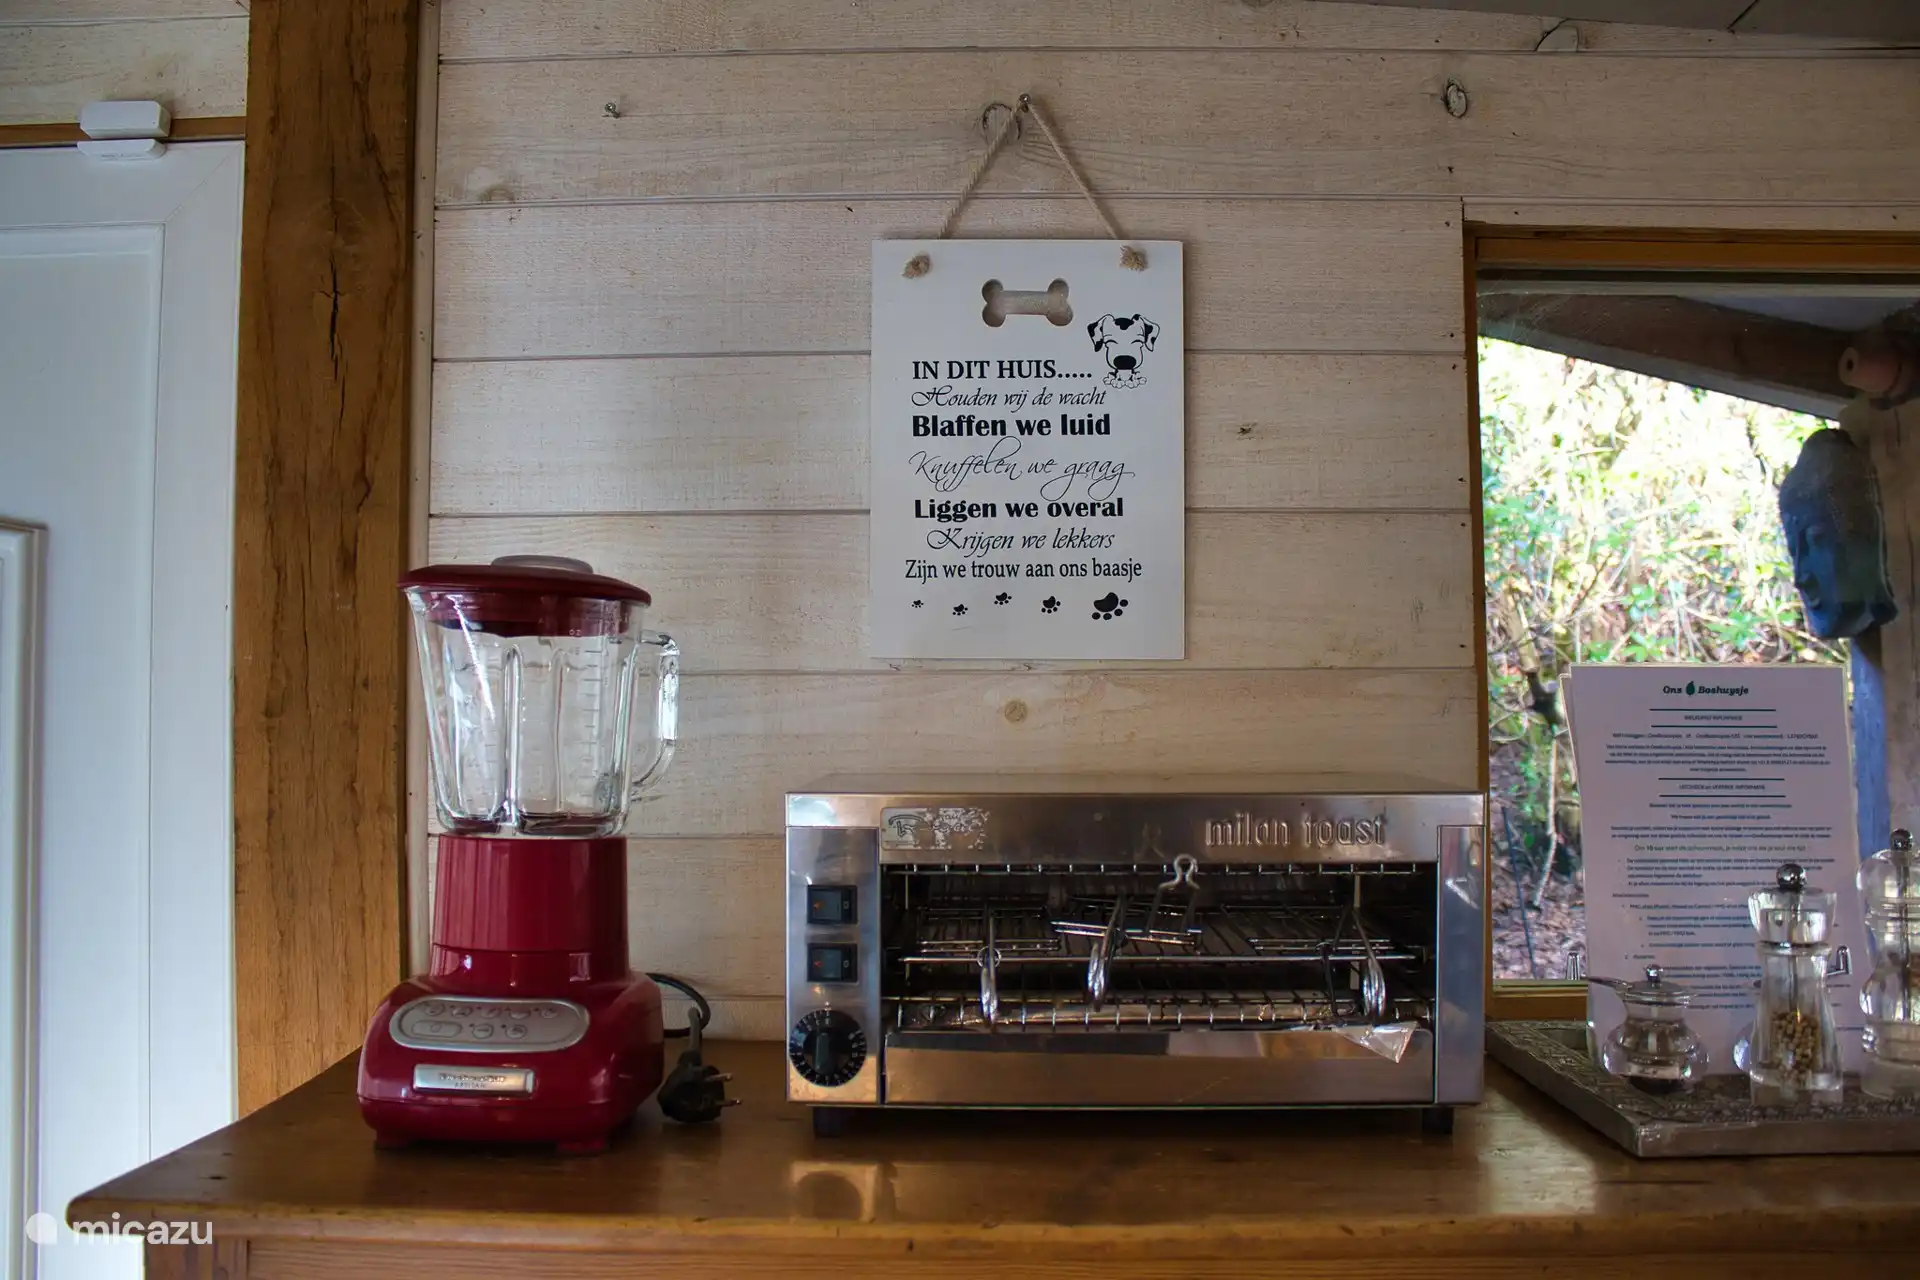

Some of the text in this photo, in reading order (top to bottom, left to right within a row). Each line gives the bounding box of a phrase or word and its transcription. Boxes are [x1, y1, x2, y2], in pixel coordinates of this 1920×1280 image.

[912, 361, 939, 379] IN
[946, 360, 990, 379] DIT
[911, 385, 1107, 413] Houden wij de wacht
[911, 413, 1111, 437] Blaffen we luid
[908, 435, 1136, 502] Knuffelen we graag
[914, 497, 1124, 523] Liggen we overal
[926, 527, 1115, 558] Krijgen we lekkers
[905, 557, 1142, 585] Zijn we trouw aan ons baasje
[1662, 684, 1749, 696] Ons Boshuysje
[1204, 811, 1388, 848] milan toast
